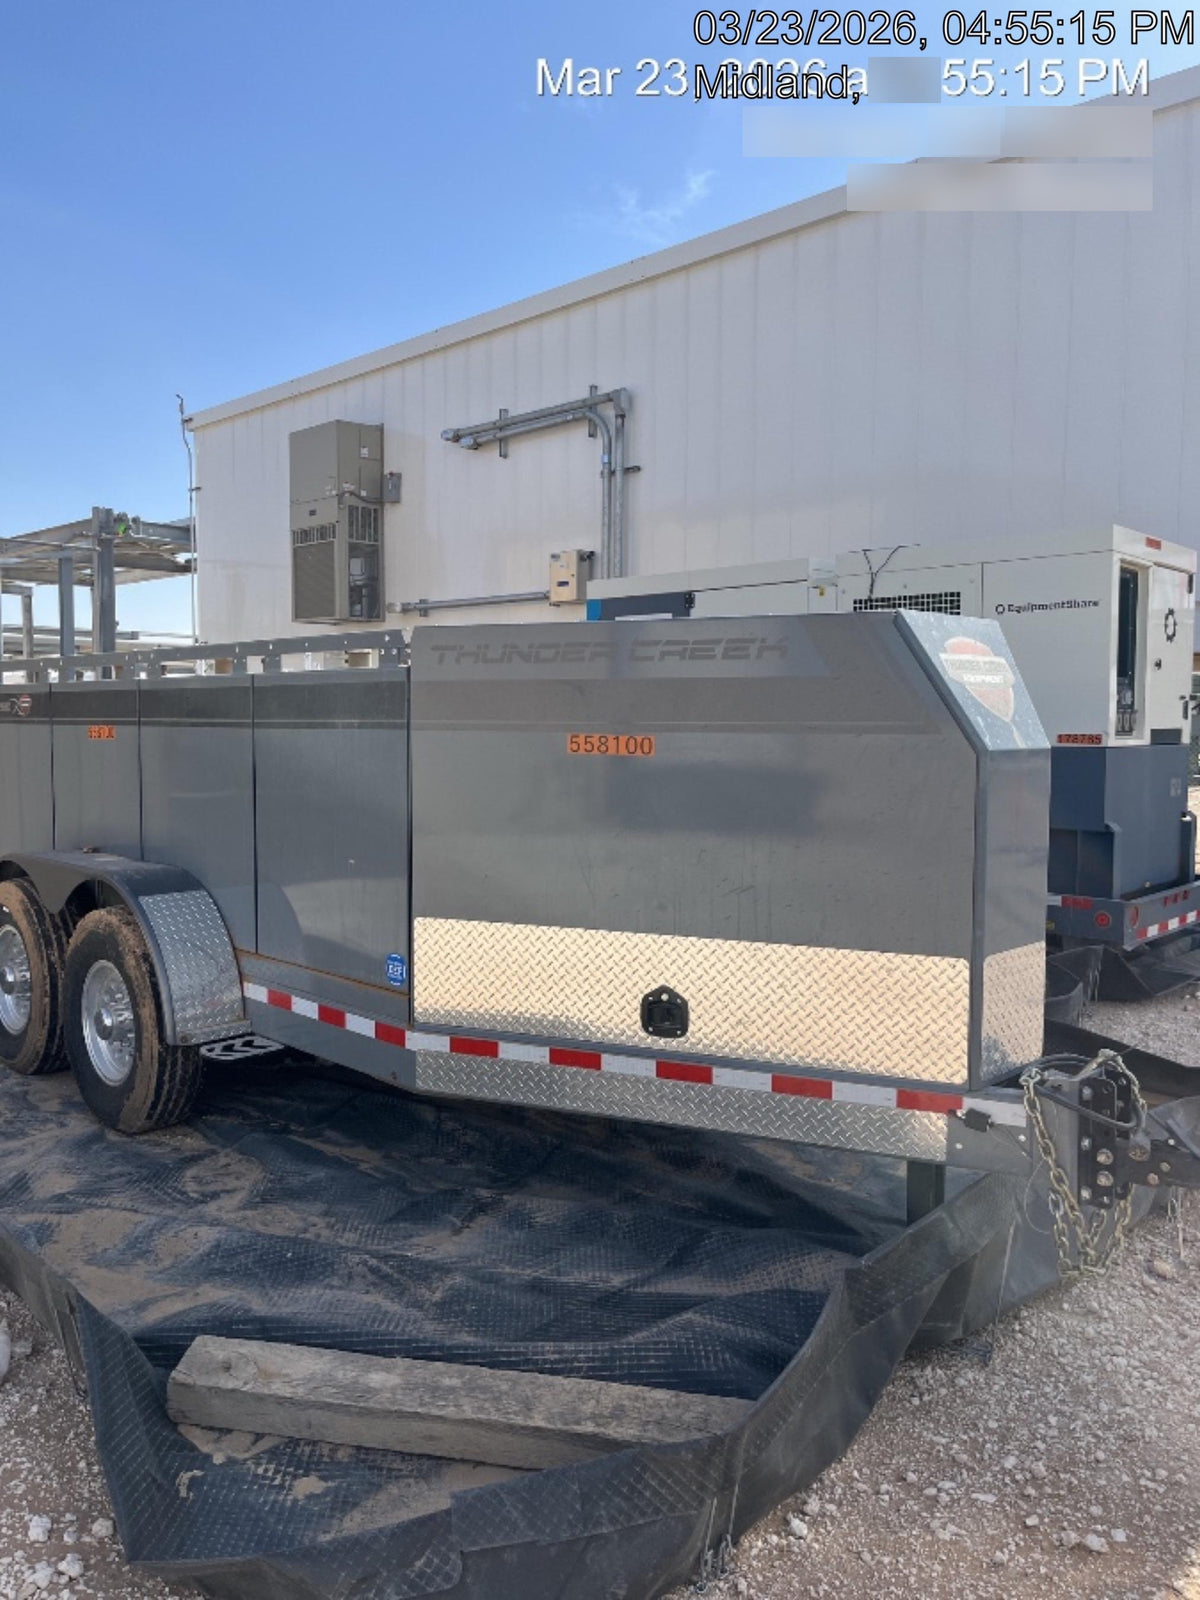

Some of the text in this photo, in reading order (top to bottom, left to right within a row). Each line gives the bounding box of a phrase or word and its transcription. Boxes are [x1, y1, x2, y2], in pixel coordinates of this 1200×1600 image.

[431, 635, 789, 666] THUNDER CREEK
[569, 735, 653, 754] 558100
